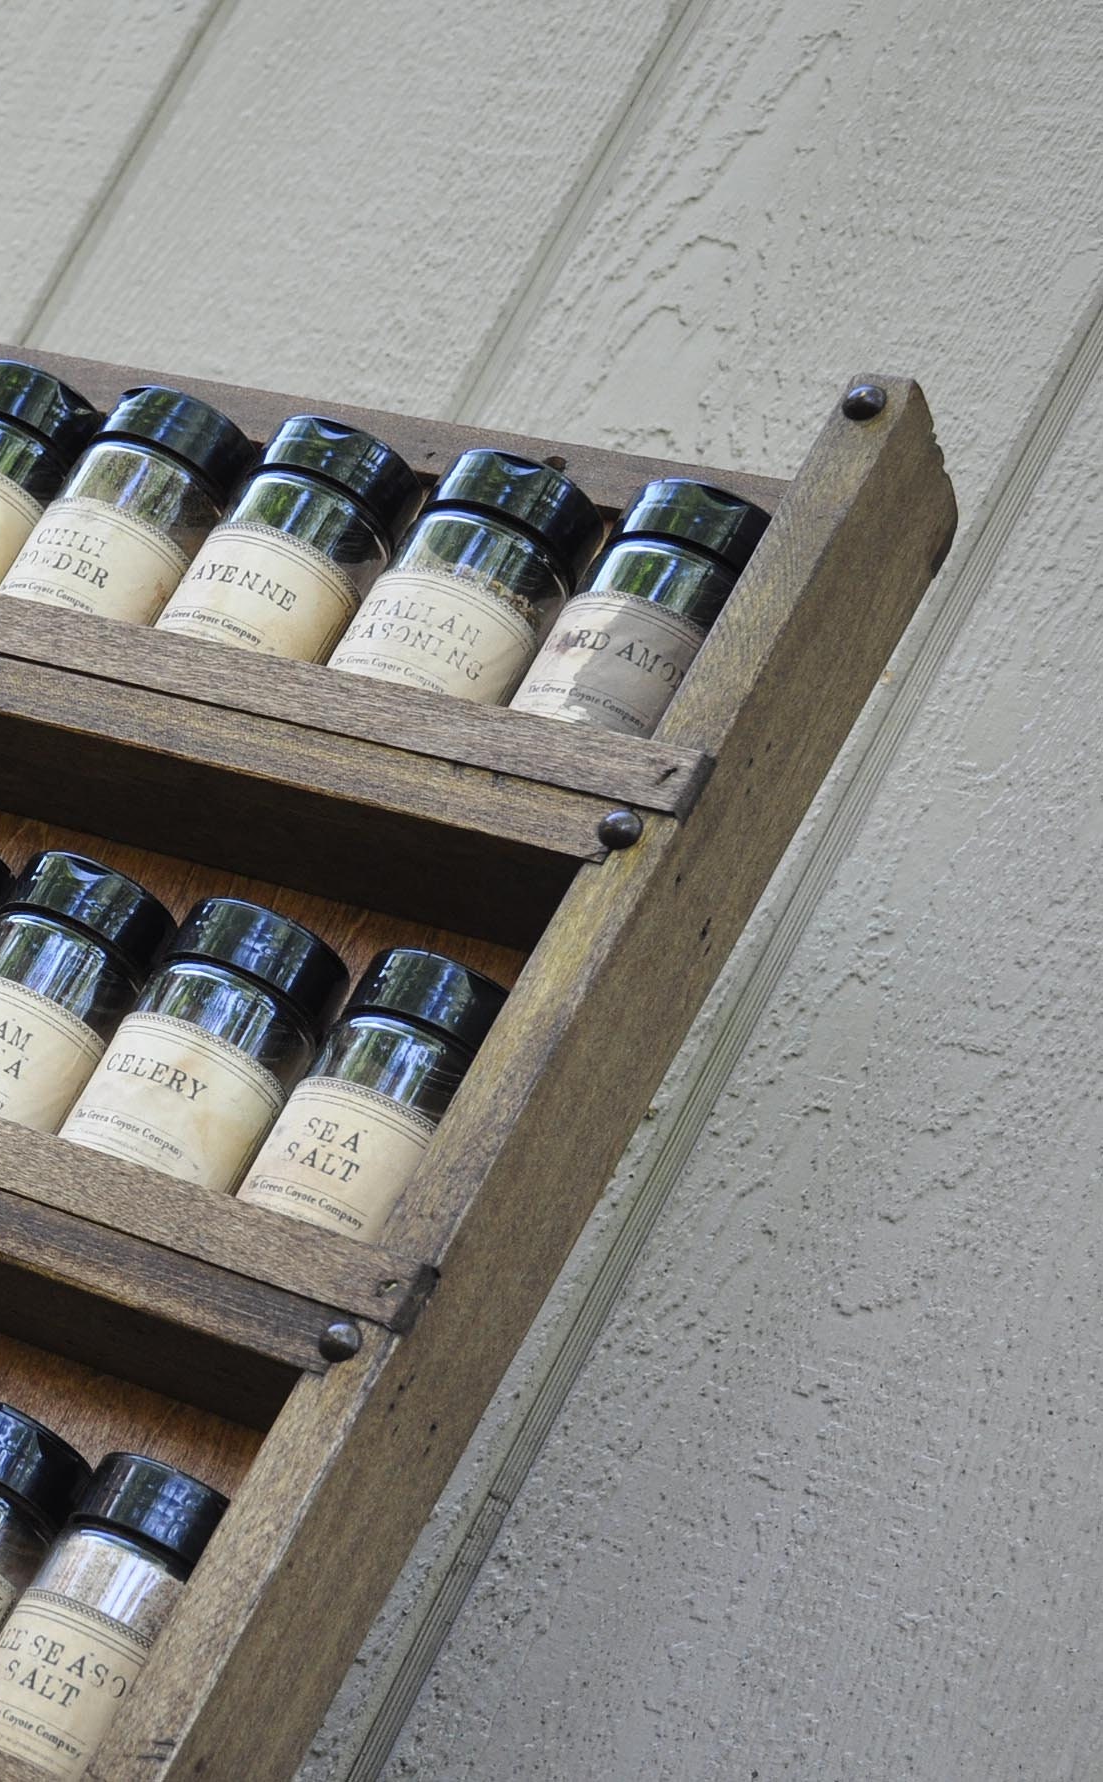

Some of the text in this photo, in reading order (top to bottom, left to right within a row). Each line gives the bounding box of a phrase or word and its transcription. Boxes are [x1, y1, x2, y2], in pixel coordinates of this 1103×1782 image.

[55, 589, 96, 614] Company
[361, 599, 482, 647] ITALIAN
[221, 617, 261, 646] Company
[403, 666, 445, 694] Company
[602, 699, 646, 730] Company
[106, 1053, 208, 1101] CELERY
[87, 1108, 110, 1123] Green
[110, 1114, 140, 1134] Coyote
[142, 1126, 184, 1160] Company
[304, 1116, 363, 1154] SEA
[284, 1140, 361, 1183] SALT
[259, 1179, 283, 1193] Green
[284, 1184, 317, 1206] Coyote
[318, 1197, 364, 1231] Company
[5, 1659, 81, 1708] SALT
[29, 1634, 128, 1699] SEASO
[2, 1707, 34, 1731] Coyote
[36, 1723, 82, 1759] Company
